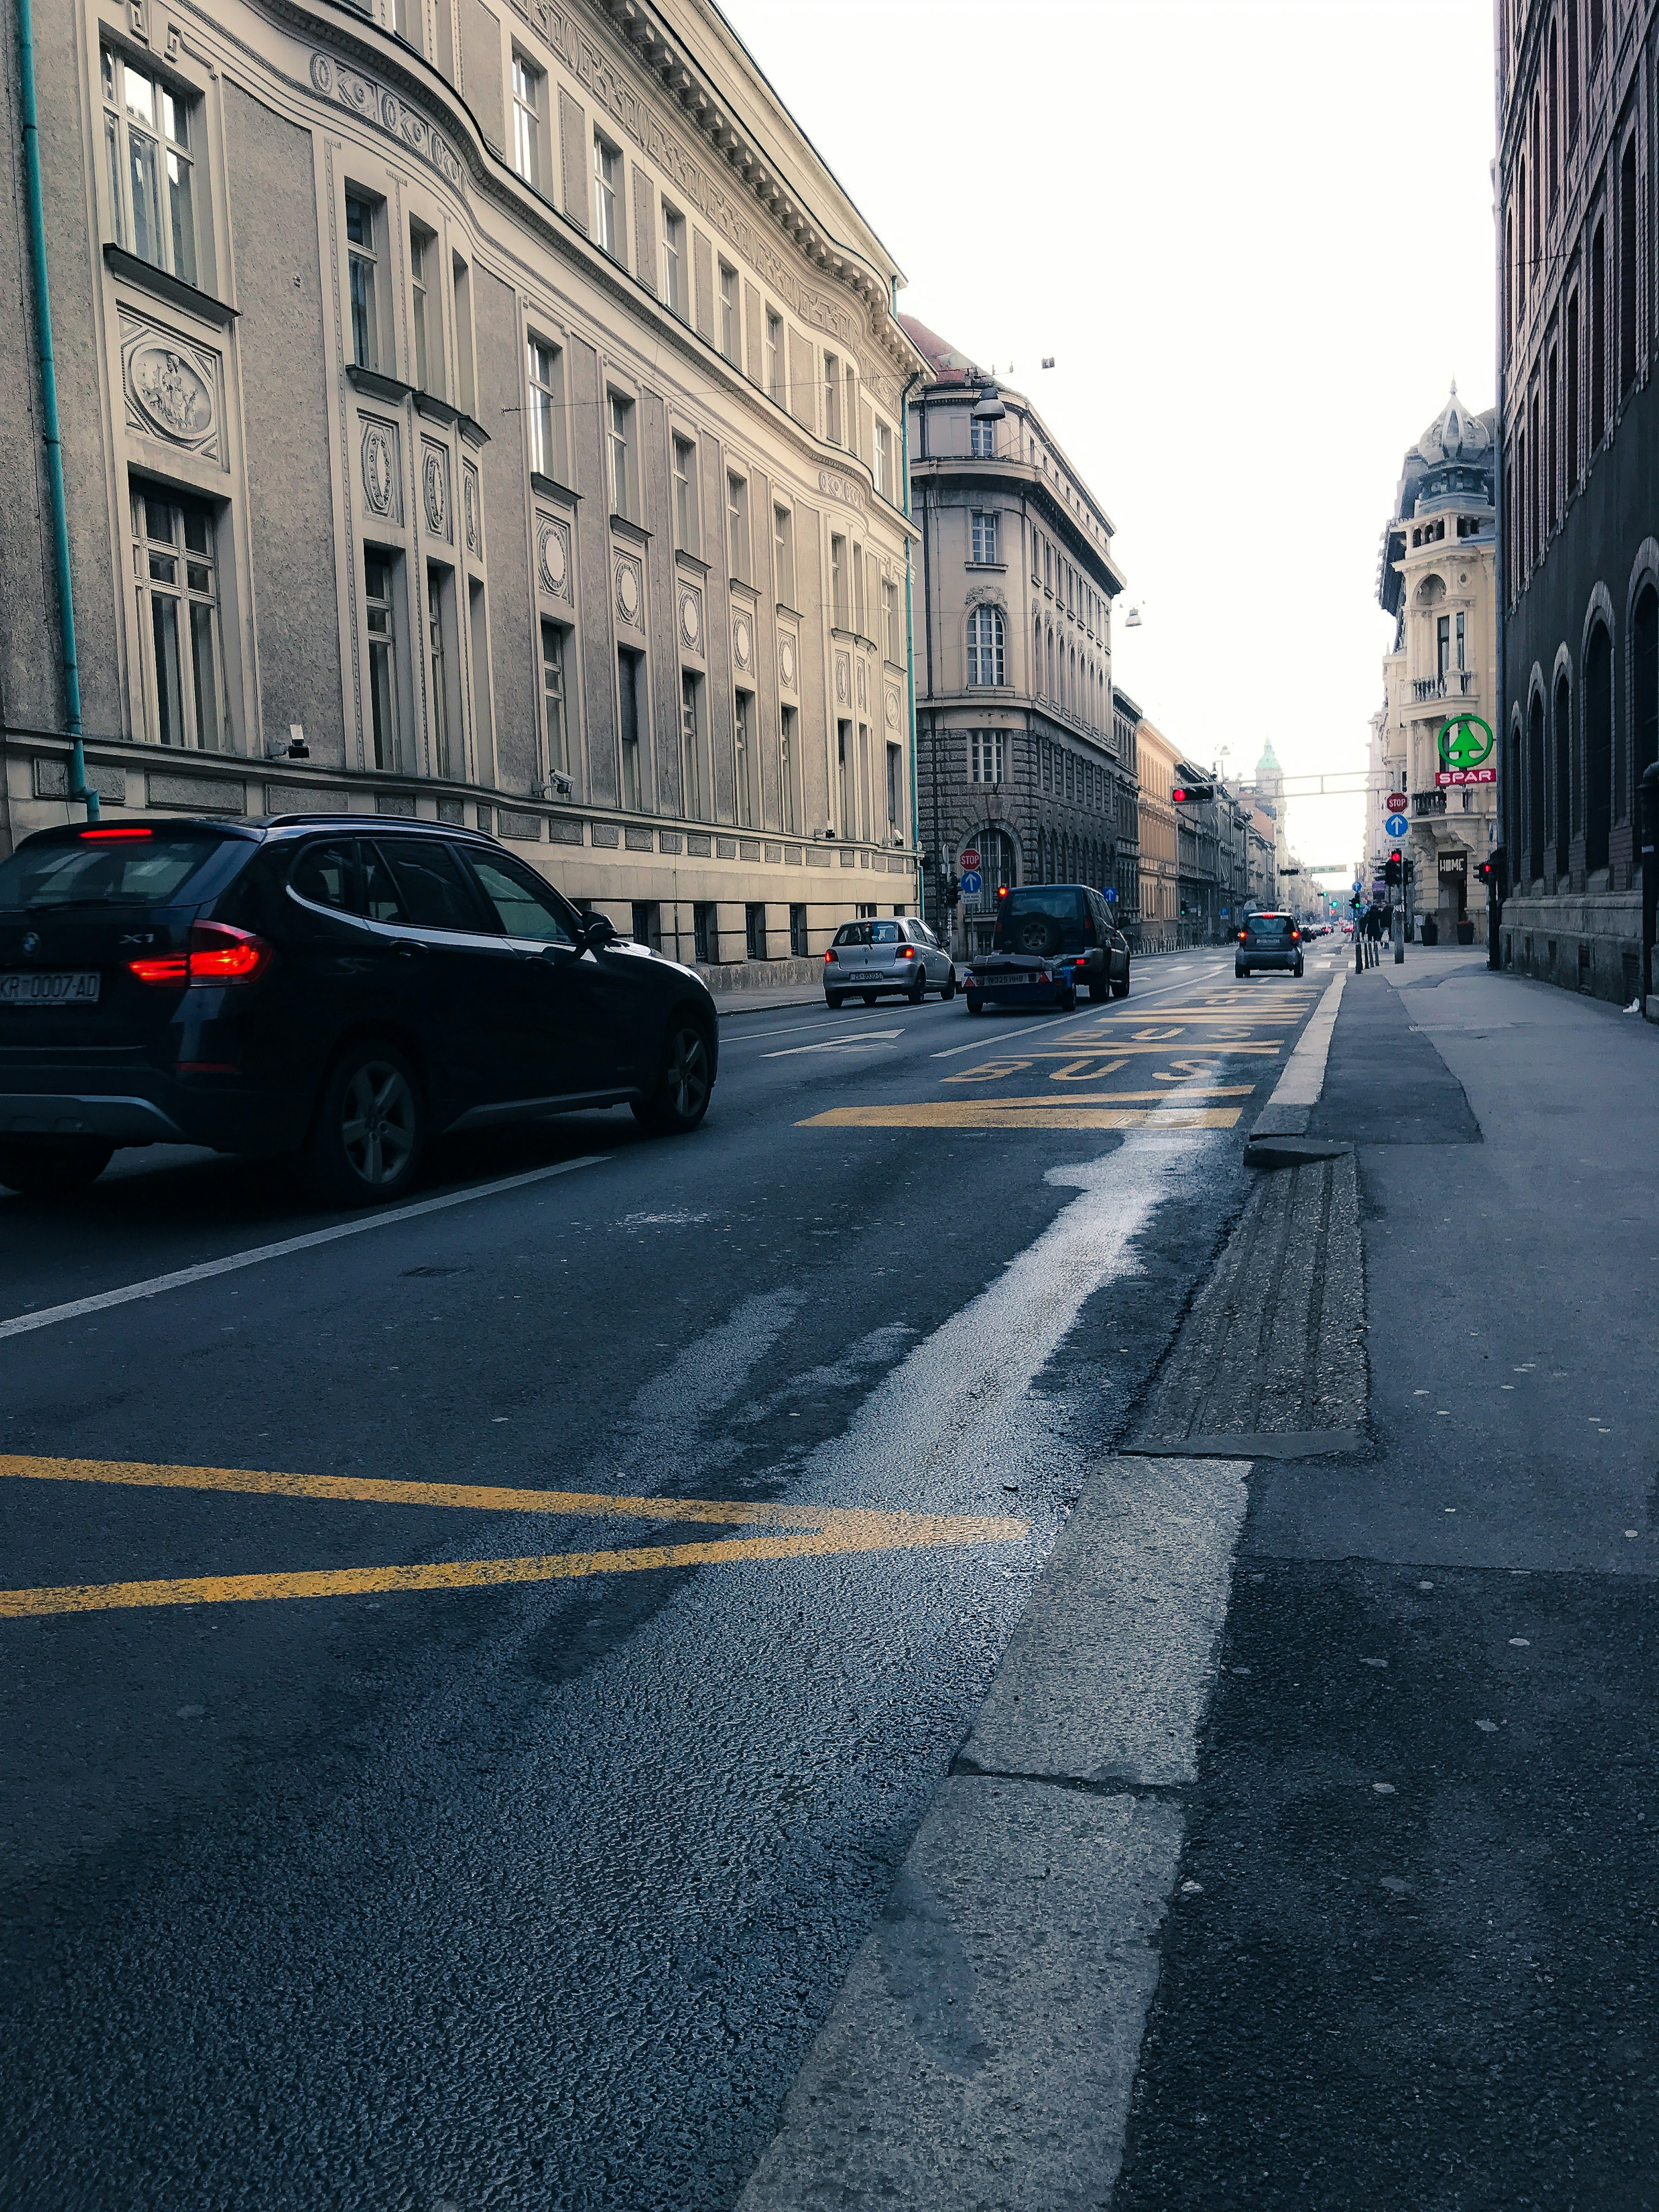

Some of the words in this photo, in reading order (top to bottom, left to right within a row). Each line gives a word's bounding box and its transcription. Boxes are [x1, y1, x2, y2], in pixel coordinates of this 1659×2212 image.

[1439, 770, 1491, 784] SPAR
[1389, 799, 1405, 807] STOP
[961, 855, 979, 864] STOP
[1440, 858, 1464, 872] HOME
[120, 934, 153, 944] X1
[31, 975, 97, 997] 0007-AD
[1054, 1027, 1255, 1040] BUS
[939, 1059, 1220, 1082] BUS
